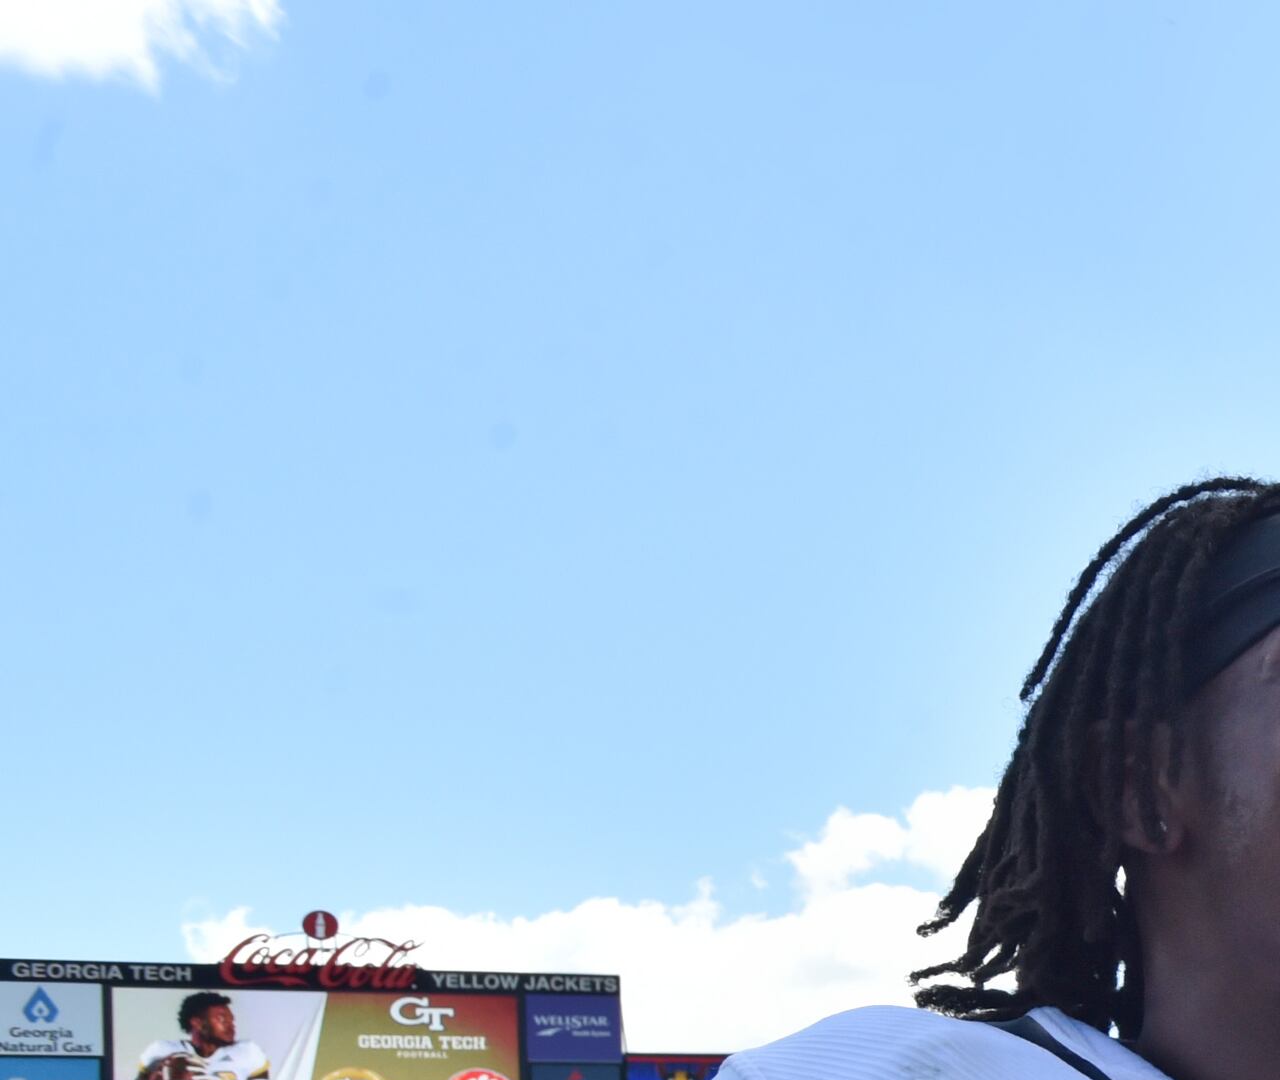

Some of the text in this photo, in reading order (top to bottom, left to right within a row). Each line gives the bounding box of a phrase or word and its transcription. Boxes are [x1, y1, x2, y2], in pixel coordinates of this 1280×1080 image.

[11, 962, 618, 993] GEORGIA TECH YELLOW JACKETS
[388, 996, 454, 1031] GT
[9, 1026, 74, 1041] Georgia
[0, 1041, 92, 1053] Natural Gas
[357, 1034, 487, 1050] GEORGIA TECH
